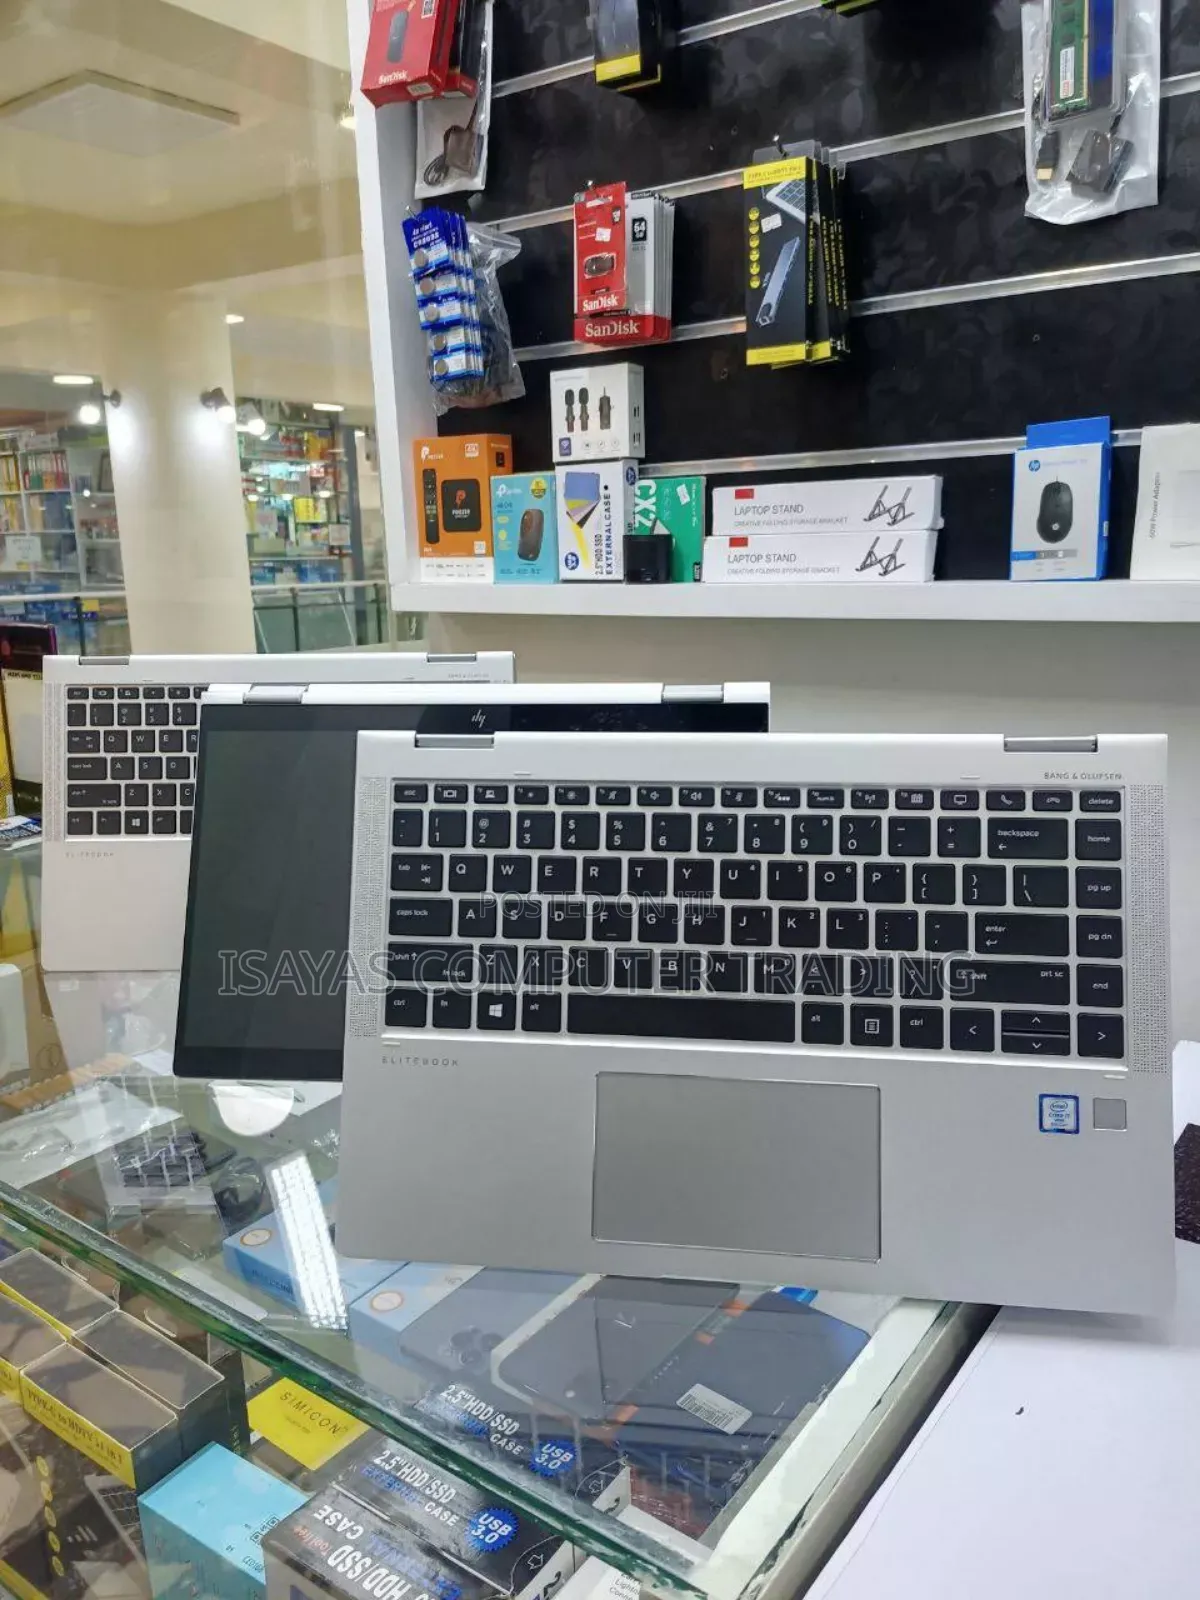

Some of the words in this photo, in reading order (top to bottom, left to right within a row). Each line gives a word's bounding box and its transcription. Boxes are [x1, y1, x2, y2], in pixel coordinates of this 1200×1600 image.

[583, 294, 619, 312] SanDisk
[585, 319, 640, 338] SanDisk
[734, 506, 770, 516] LAPTOP
[772, 504, 804, 515] STAND
[604, 523, 612, 575] EXTERNAL
[728, 555, 763, 564] LAPTOP
[765, 553, 797, 563] STAND
[1044, 772, 1069, 780] BANG
[1072, 772, 1078, 780] &
[1080, 772, 1123, 780] OLUFSEN
[568, 819, 576, 829] $
[613, 820, 623, 830] %
[705, 822, 714, 831] &
[435, 832, 440, 842] 1
[479, 833, 486, 843] 2
[997, 829, 1040, 838] backspace
[523, 834, 531, 844] 3
[568, 834, 576, 844] 4
[613, 835, 621, 845] 5
[659, 836, 667, 846] 6
[706, 837, 713, 847] 7
[752, 838, 761, 848] 8
[800, 838, 808, 848] 9
[456, 863, 466, 875] Q
[500, 865, 515, 876] W
[545, 866, 553, 876] E
[590, 866, 599, 877] R
[635, 867, 644, 878] T
[682, 869, 692, 879] Y
[728, 870, 738, 880] U
[824, 871, 835, 882] O
[872, 873, 881, 883] P
[466, 909, 475, 919] A
[510, 910, 518, 920] S
[554, 911, 564, 921] D
[600, 912, 608, 922] F
[646, 914, 656, 924] G
[692, 915, 702, 925] H
[739, 916, 747, 926] J
[787, 918, 797, 928] K
[836, 919, 844, 930] L
[486, 955, 494, 965] Z
[532, 956, 539, 966] X
[577, 957, 586, 968] C
[623, 960, 631, 969] V
[669, 961, 677, 971] B
[715, 963, 725, 972] N
[764, 964, 774, 974] M
[1093, 982, 1109, 990] end
[910, 1018, 923, 1026] ctrl
[382, 1056, 459, 1067] ELITEBOOK
[280, 1391, 341, 1435] SIMICON
[490, 1434, 524, 1455] CASE
[541, 1443, 573, 1462] USB
[535, 1453, 561, 1470] 3.0
[424, 1502, 460, 1527] CASE
[314, 1504, 365, 1540] CASE
[479, 1513, 512, 1535] USB
[471, 1524, 500, 1544] 3.0
